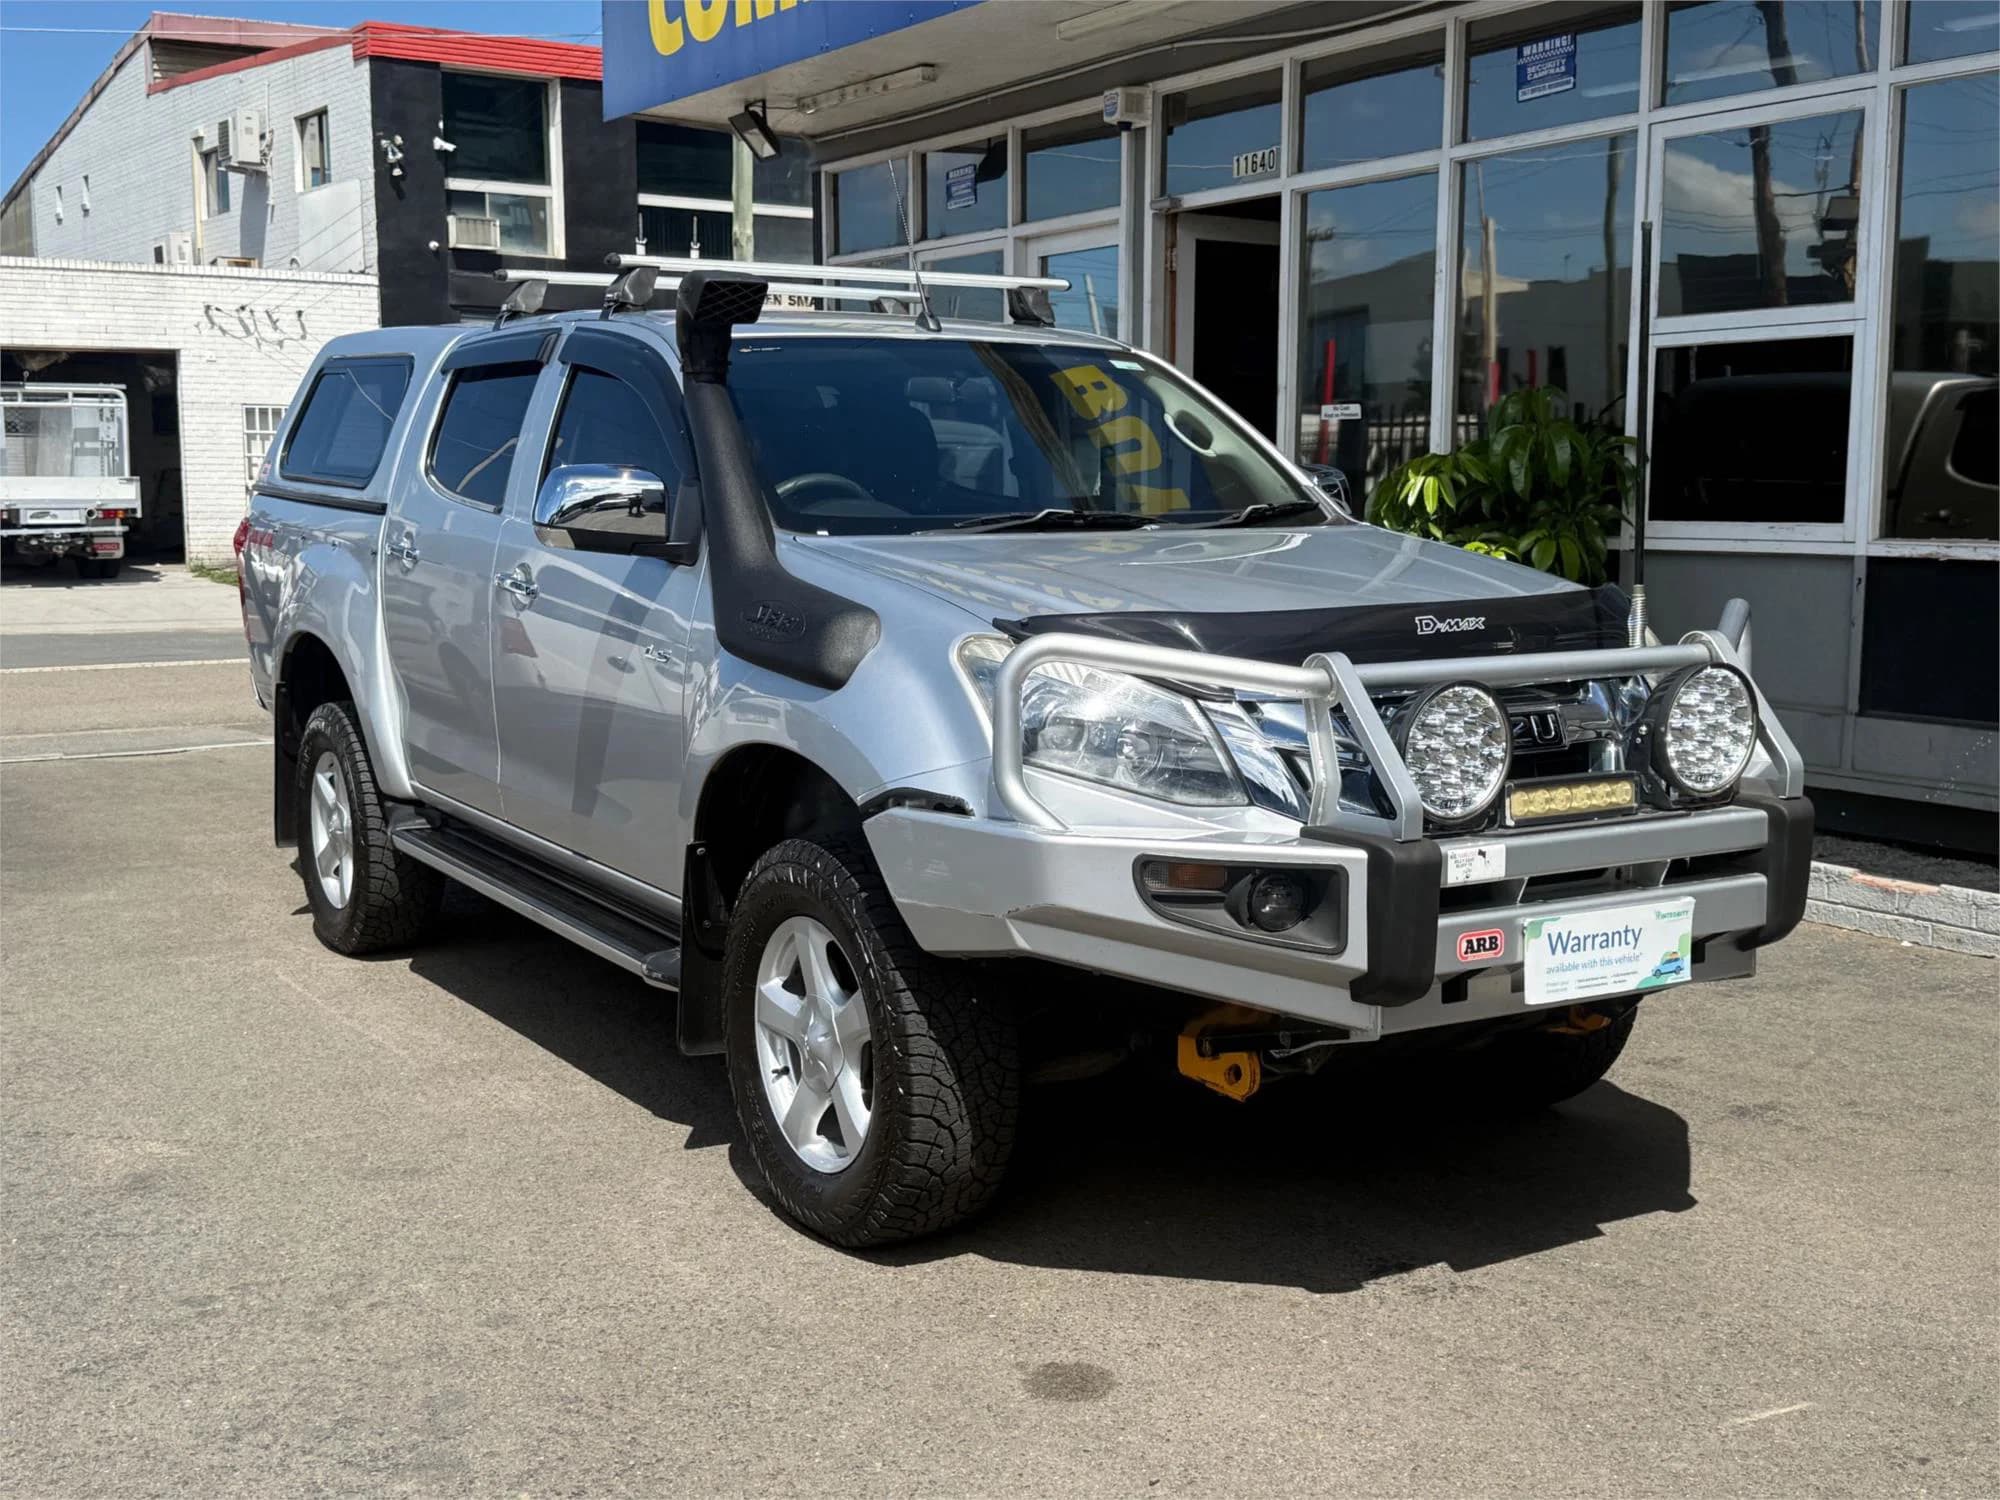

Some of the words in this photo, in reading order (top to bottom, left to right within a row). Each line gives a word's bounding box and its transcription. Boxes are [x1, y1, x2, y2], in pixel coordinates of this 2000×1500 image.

[1236, 149, 1275, 177] 11640
[1464, 936, 1499, 955] ARB
[1547, 925, 1643, 956] Warranty
[1546, 961, 1581, 974] available
[1581, 958, 1598, 970] with
[1600, 956, 1612, 967] this
